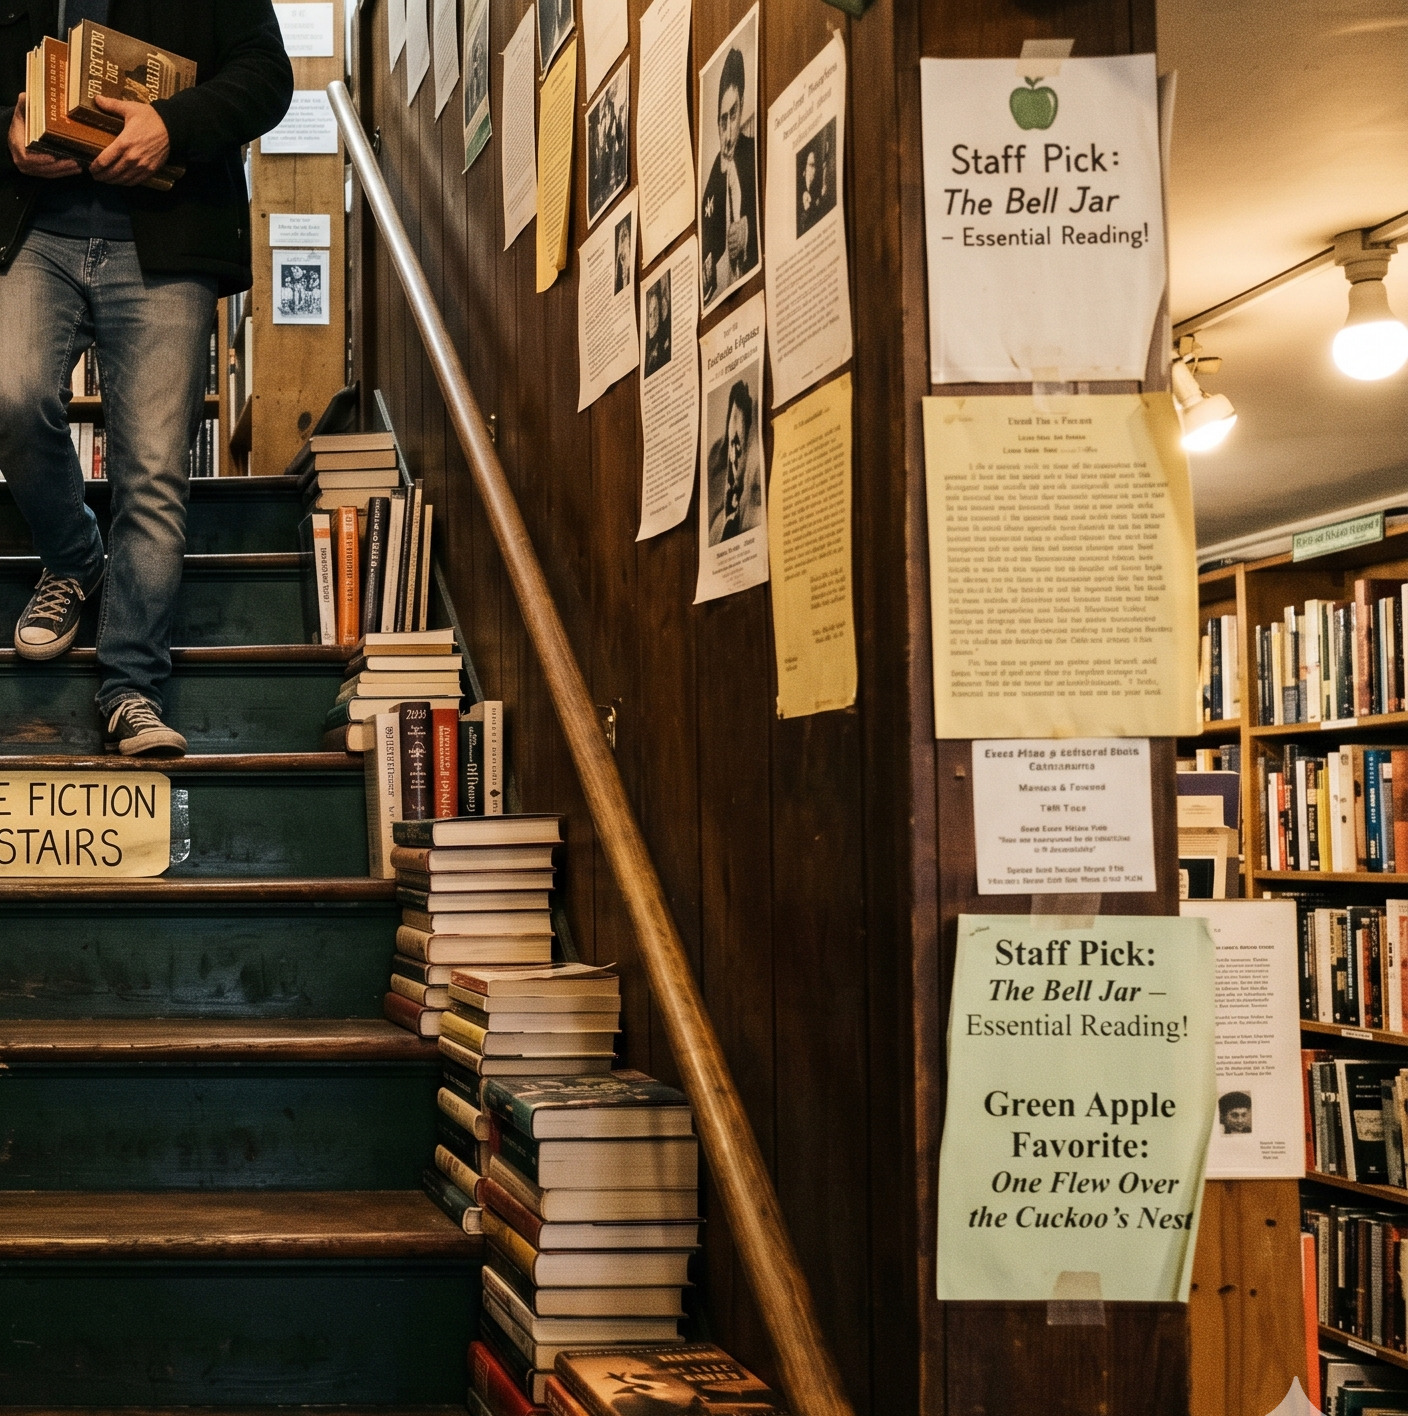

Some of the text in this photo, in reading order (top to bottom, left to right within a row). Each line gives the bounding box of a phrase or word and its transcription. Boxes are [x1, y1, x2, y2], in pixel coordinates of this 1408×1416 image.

[951, 143, 1120, 175] Staff Pick:
[943, 186, 1120, 216] The Bell Jar
[962, 226, 1051, 247] Essential
[1061, 222, 1149, 249] Reading!
[29, 783, 156, 818] FICTION
[995, 939, 1155, 967] Staff Pick:
[988, 979, 1035, 1002] The
[1042, 979, 1092, 1002] Bell
[1098, 979, 1141, 1002] Jar
[965, 1013, 1189, 1044] Essential Reading!
[983, 1090, 1176, 1125] Green Apple
[1011, 1131, 1149, 1159] Favorite:
[991, 1170, 1180, 1194] One Flew Over
[968, 1206, 1194, 1231] the Cuckoo’s Nest
